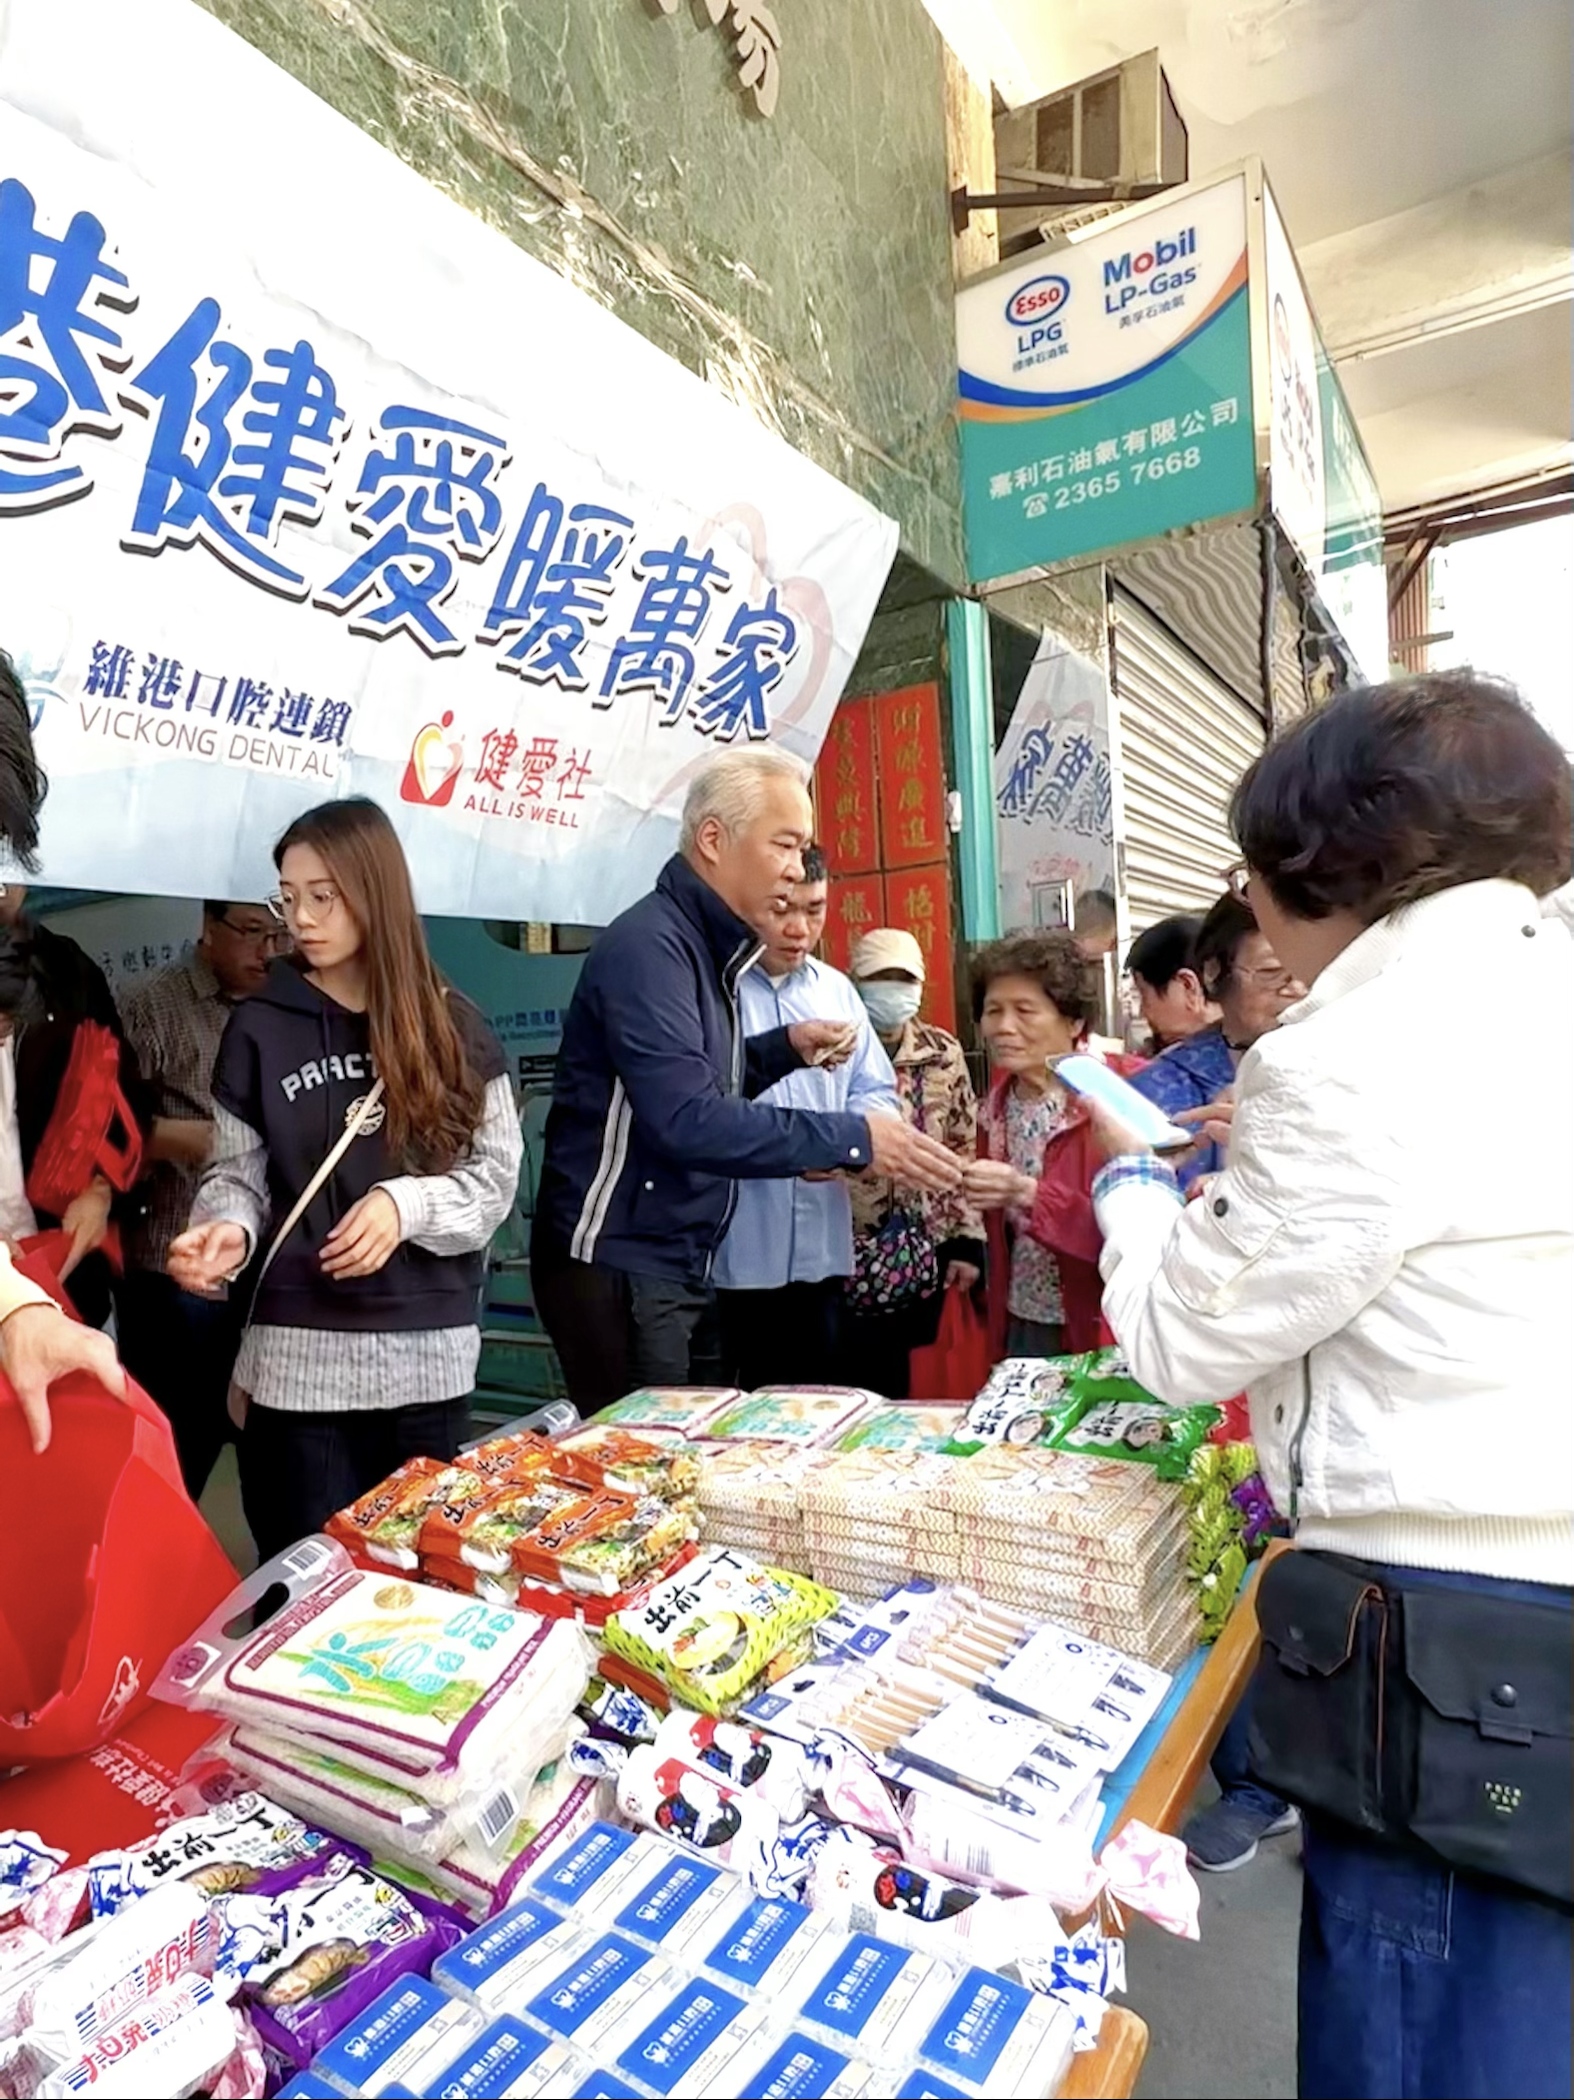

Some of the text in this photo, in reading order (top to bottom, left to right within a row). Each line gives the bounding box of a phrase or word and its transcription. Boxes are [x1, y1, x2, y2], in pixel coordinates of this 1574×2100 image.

[1103, 227, 1196, 287] Mobil
[1104, 266, 1197, 314] LP-Gas
[1018, 321, 1063, 353] LPG
[989, 397, 1239, 499] 嘉利石油氣有限公司
[1054, 446, 1202, 510] 2365 7668
[82, 640, 352, 747] 維港口腔連鎖
[80, 702, 333, 778] VICKONG DENTAL
[474, 728, 592, 801] 健愛社
[531, 806, 579, 828] WELL
[644, 1550, 742, 1634] 出前一丁
[142, 1807, 274, 1876] 出前一丁
